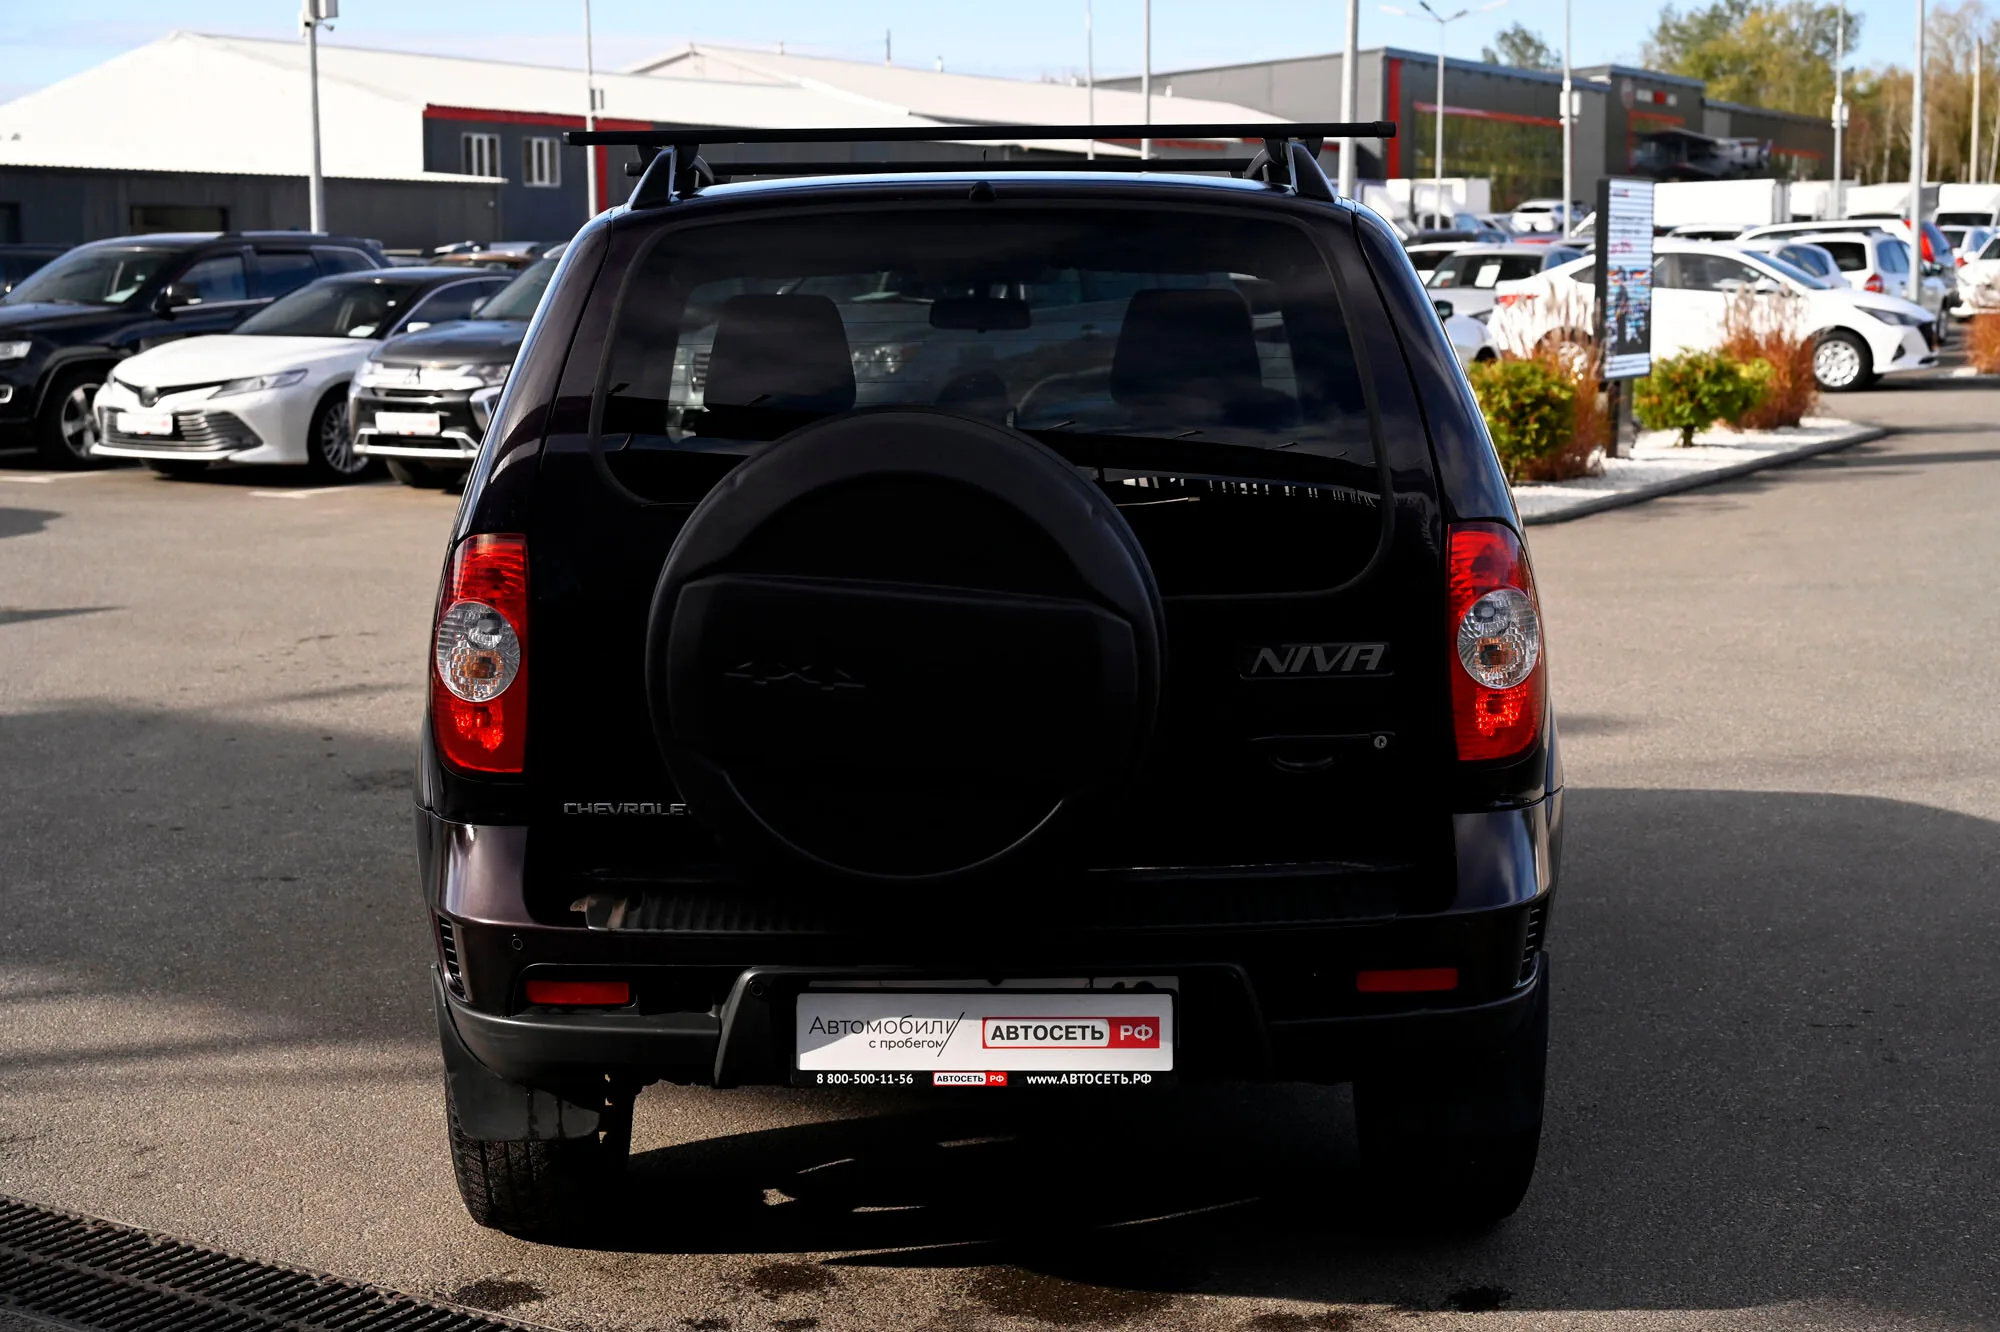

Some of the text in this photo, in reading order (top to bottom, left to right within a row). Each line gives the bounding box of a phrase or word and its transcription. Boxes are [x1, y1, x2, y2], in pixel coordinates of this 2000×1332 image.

[1251, 644, 1385, 674] NIVA
[563, 802, 690, 816] CHEVROLE
[990, 1023, 1153, 1041] АВТОСЕТЬ РФ
[868, 1037, 945, 1050] с пробегом
[816, 1073, 914, 1085] 8 800-500-11-56
[936, 1074, 1005, 1083] АВТОСЕТЬ РФ
[1026, 1073, 1152, 1085] www.АВТОСЕТЬ.РФ
